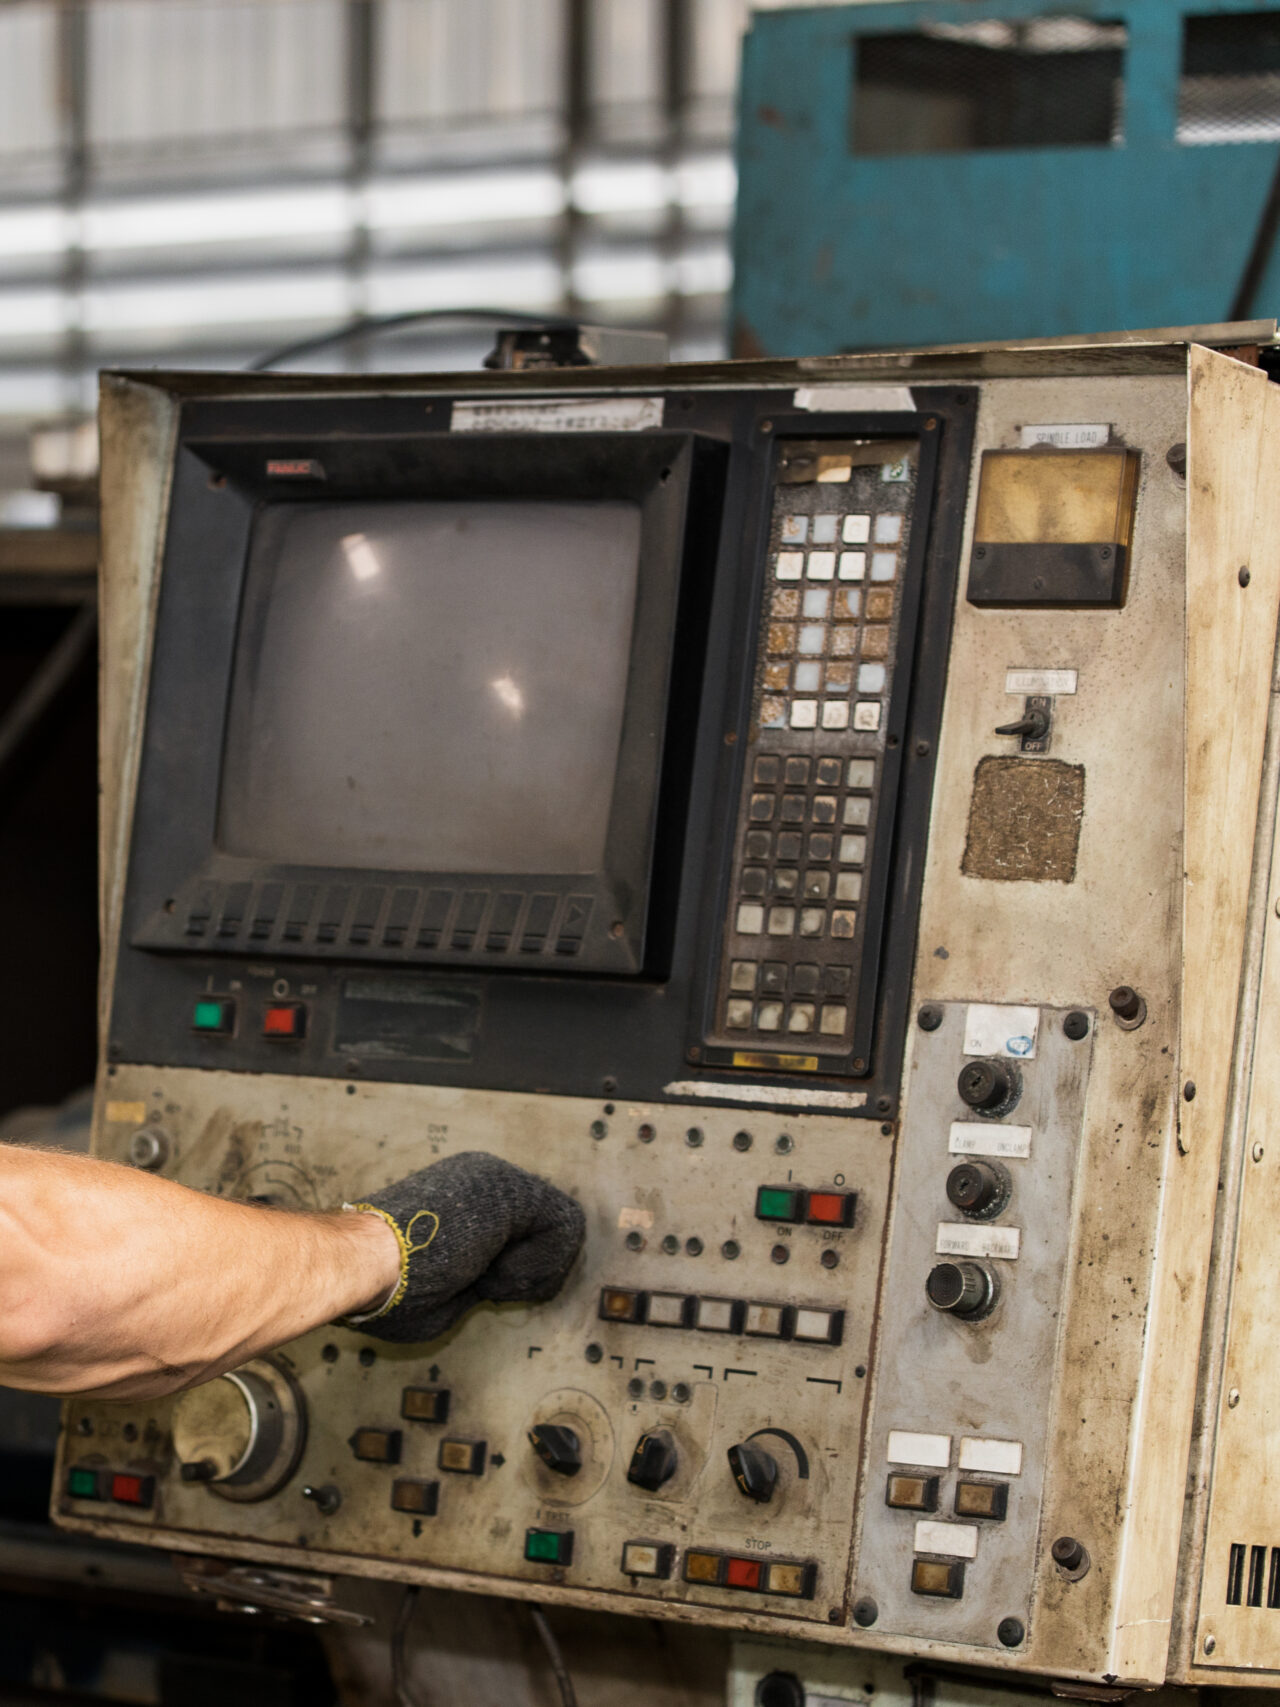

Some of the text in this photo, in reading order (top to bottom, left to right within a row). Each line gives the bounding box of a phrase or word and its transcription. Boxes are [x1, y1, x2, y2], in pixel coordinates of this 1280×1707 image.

[1036, 431, 1097, 443] SPINDLE LOAD
[970, 1039, 982, 1048] ON
[777, 1226, 843, 1241] ON OFF
[745, 1538, 771, 1551] STOP
